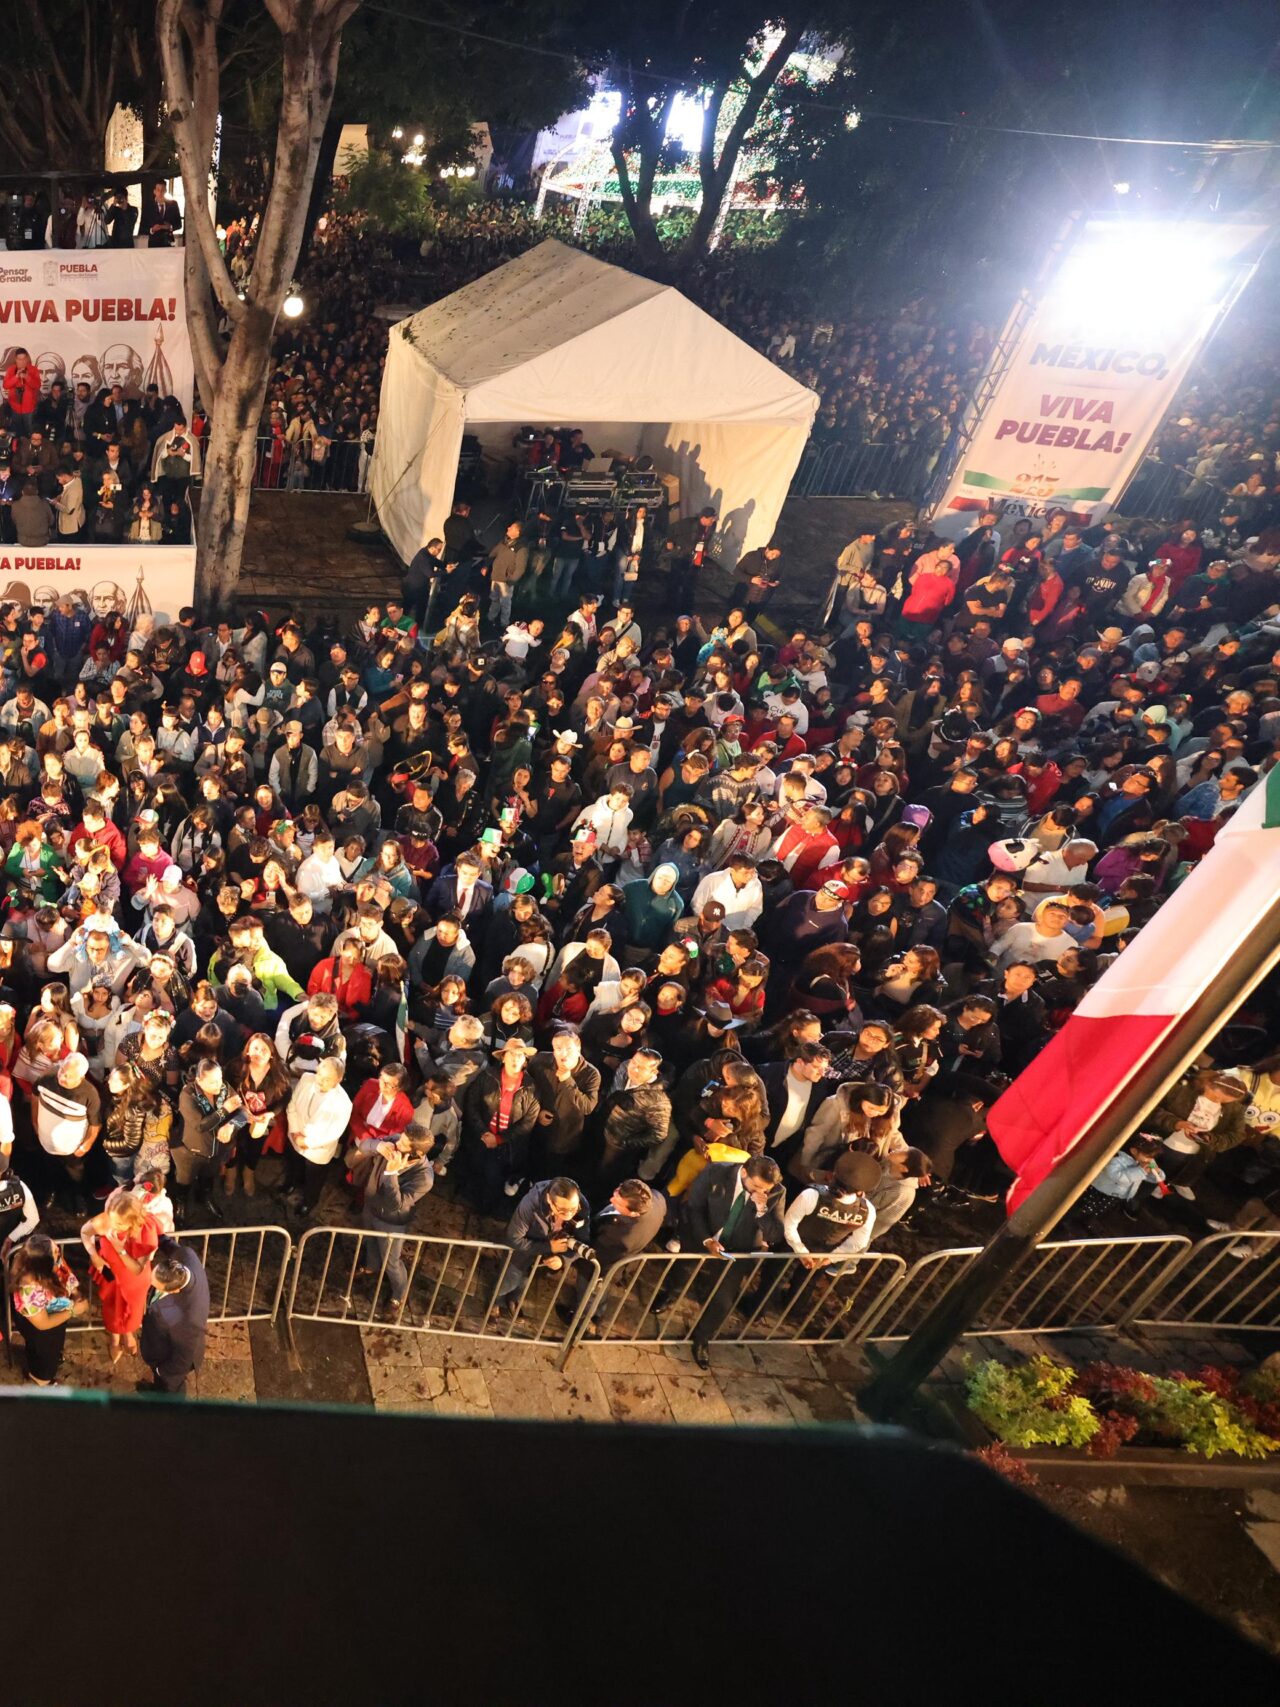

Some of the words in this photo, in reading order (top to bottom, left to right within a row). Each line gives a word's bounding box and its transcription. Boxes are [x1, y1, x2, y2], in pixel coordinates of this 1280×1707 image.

[0, 274, 33, 283] Grande
[60, 264, 98, 273] PUEBLA
[65, 298, 177, 322] PUEBLA!
[1029, 341, 1170, 381] MÉXICO,
[1039, 394, 1114, 424] VIVA
[994, 419, 1132, 454] PUEBLA!
[14, 557, 81, 571] PUEBLA!
